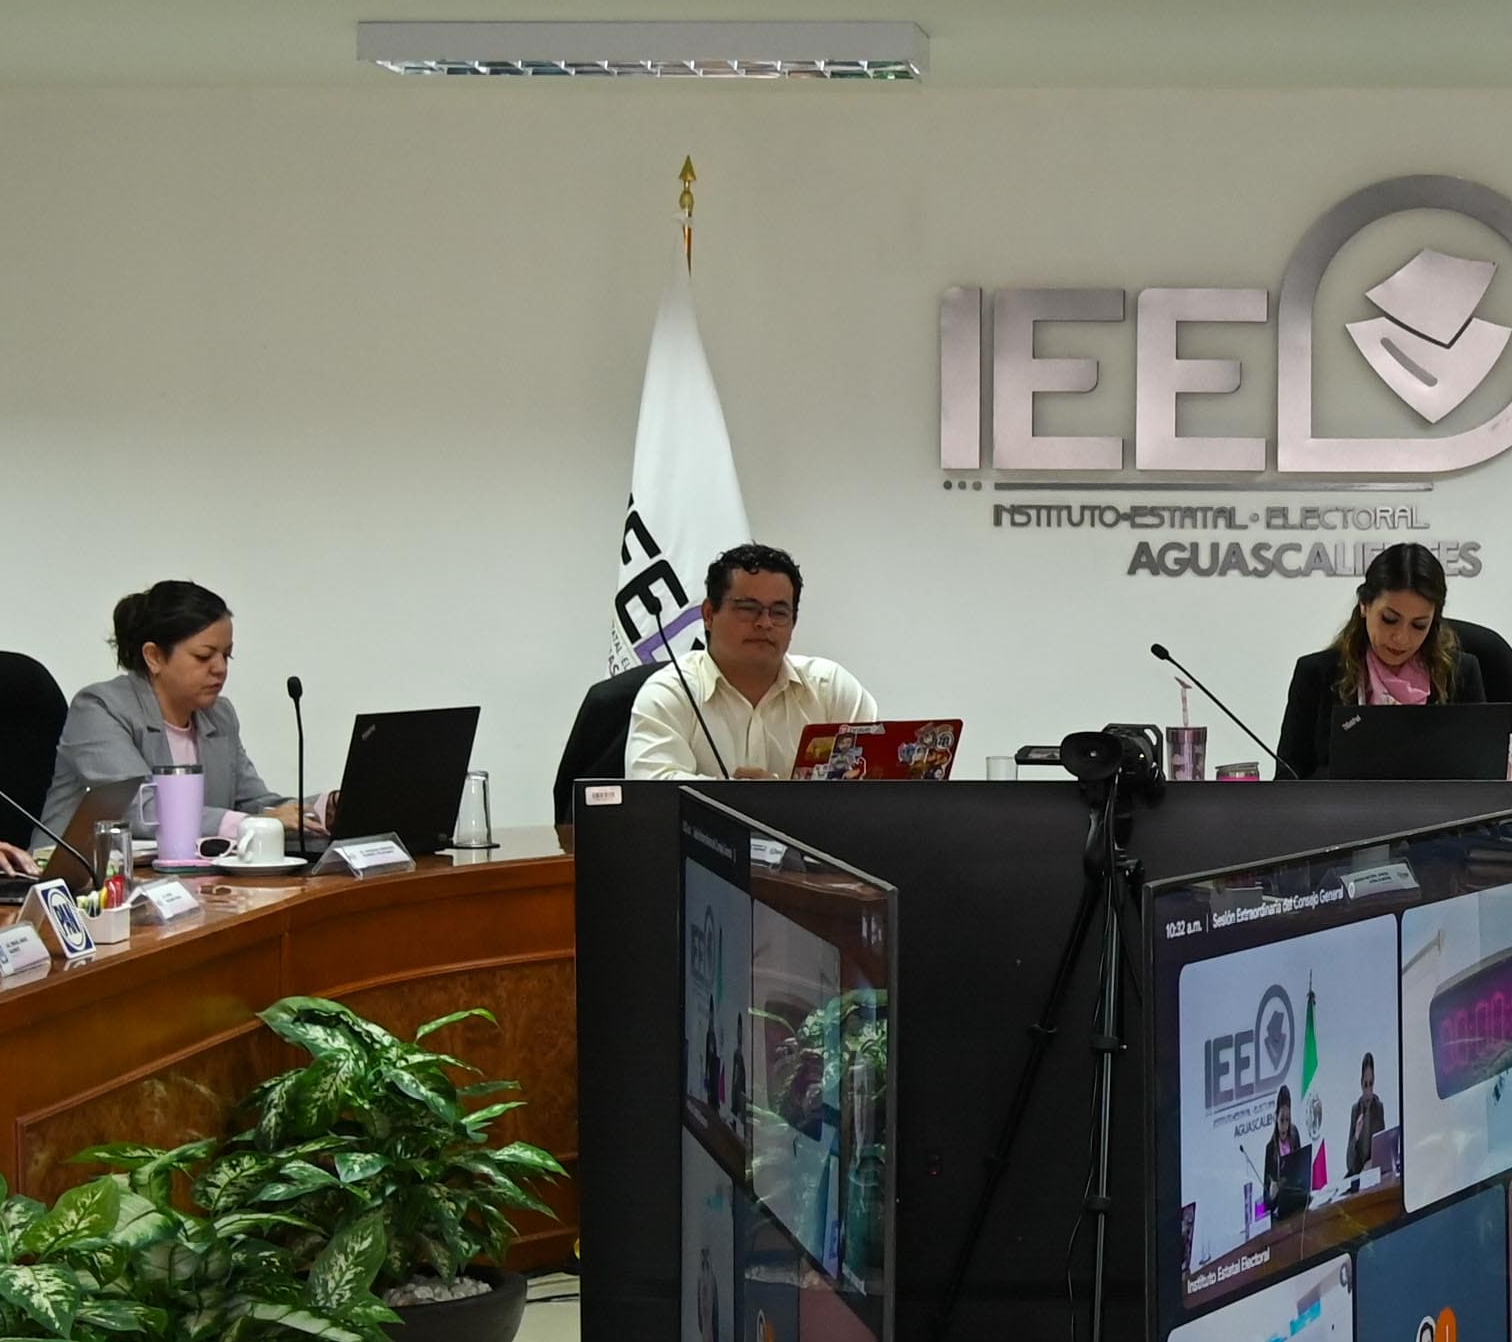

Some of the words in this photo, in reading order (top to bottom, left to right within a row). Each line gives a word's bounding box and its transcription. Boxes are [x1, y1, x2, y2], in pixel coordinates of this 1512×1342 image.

[992, 504, 1121, 529] INSTITUTO
[1129, 505, 1248, 529] ESTATAL
[1264, 505, 1431, 530] ELECTORAL
[614, 492, 689, 644] EE
[1127, 541, 1483, 578] AGUASCALIEES
[53, 903, 80, 937] PAN
[1165, 920, 1186, 939] 10:32
[1187, 918, 1203, 934] a.m.
[1212, 910, 1236, 929] Sesión
[1236, 899, 1282, 923] Extraordinaria
[1293, 890, 1319, 910] Consejo
[1319, 884, 1344, 904] General
[1186, 1271, 1217, 1295] Instituto
[1217, 1258, 1241, 1282] Estatal
[1241, 1245, 1271, 1272] Electoral
